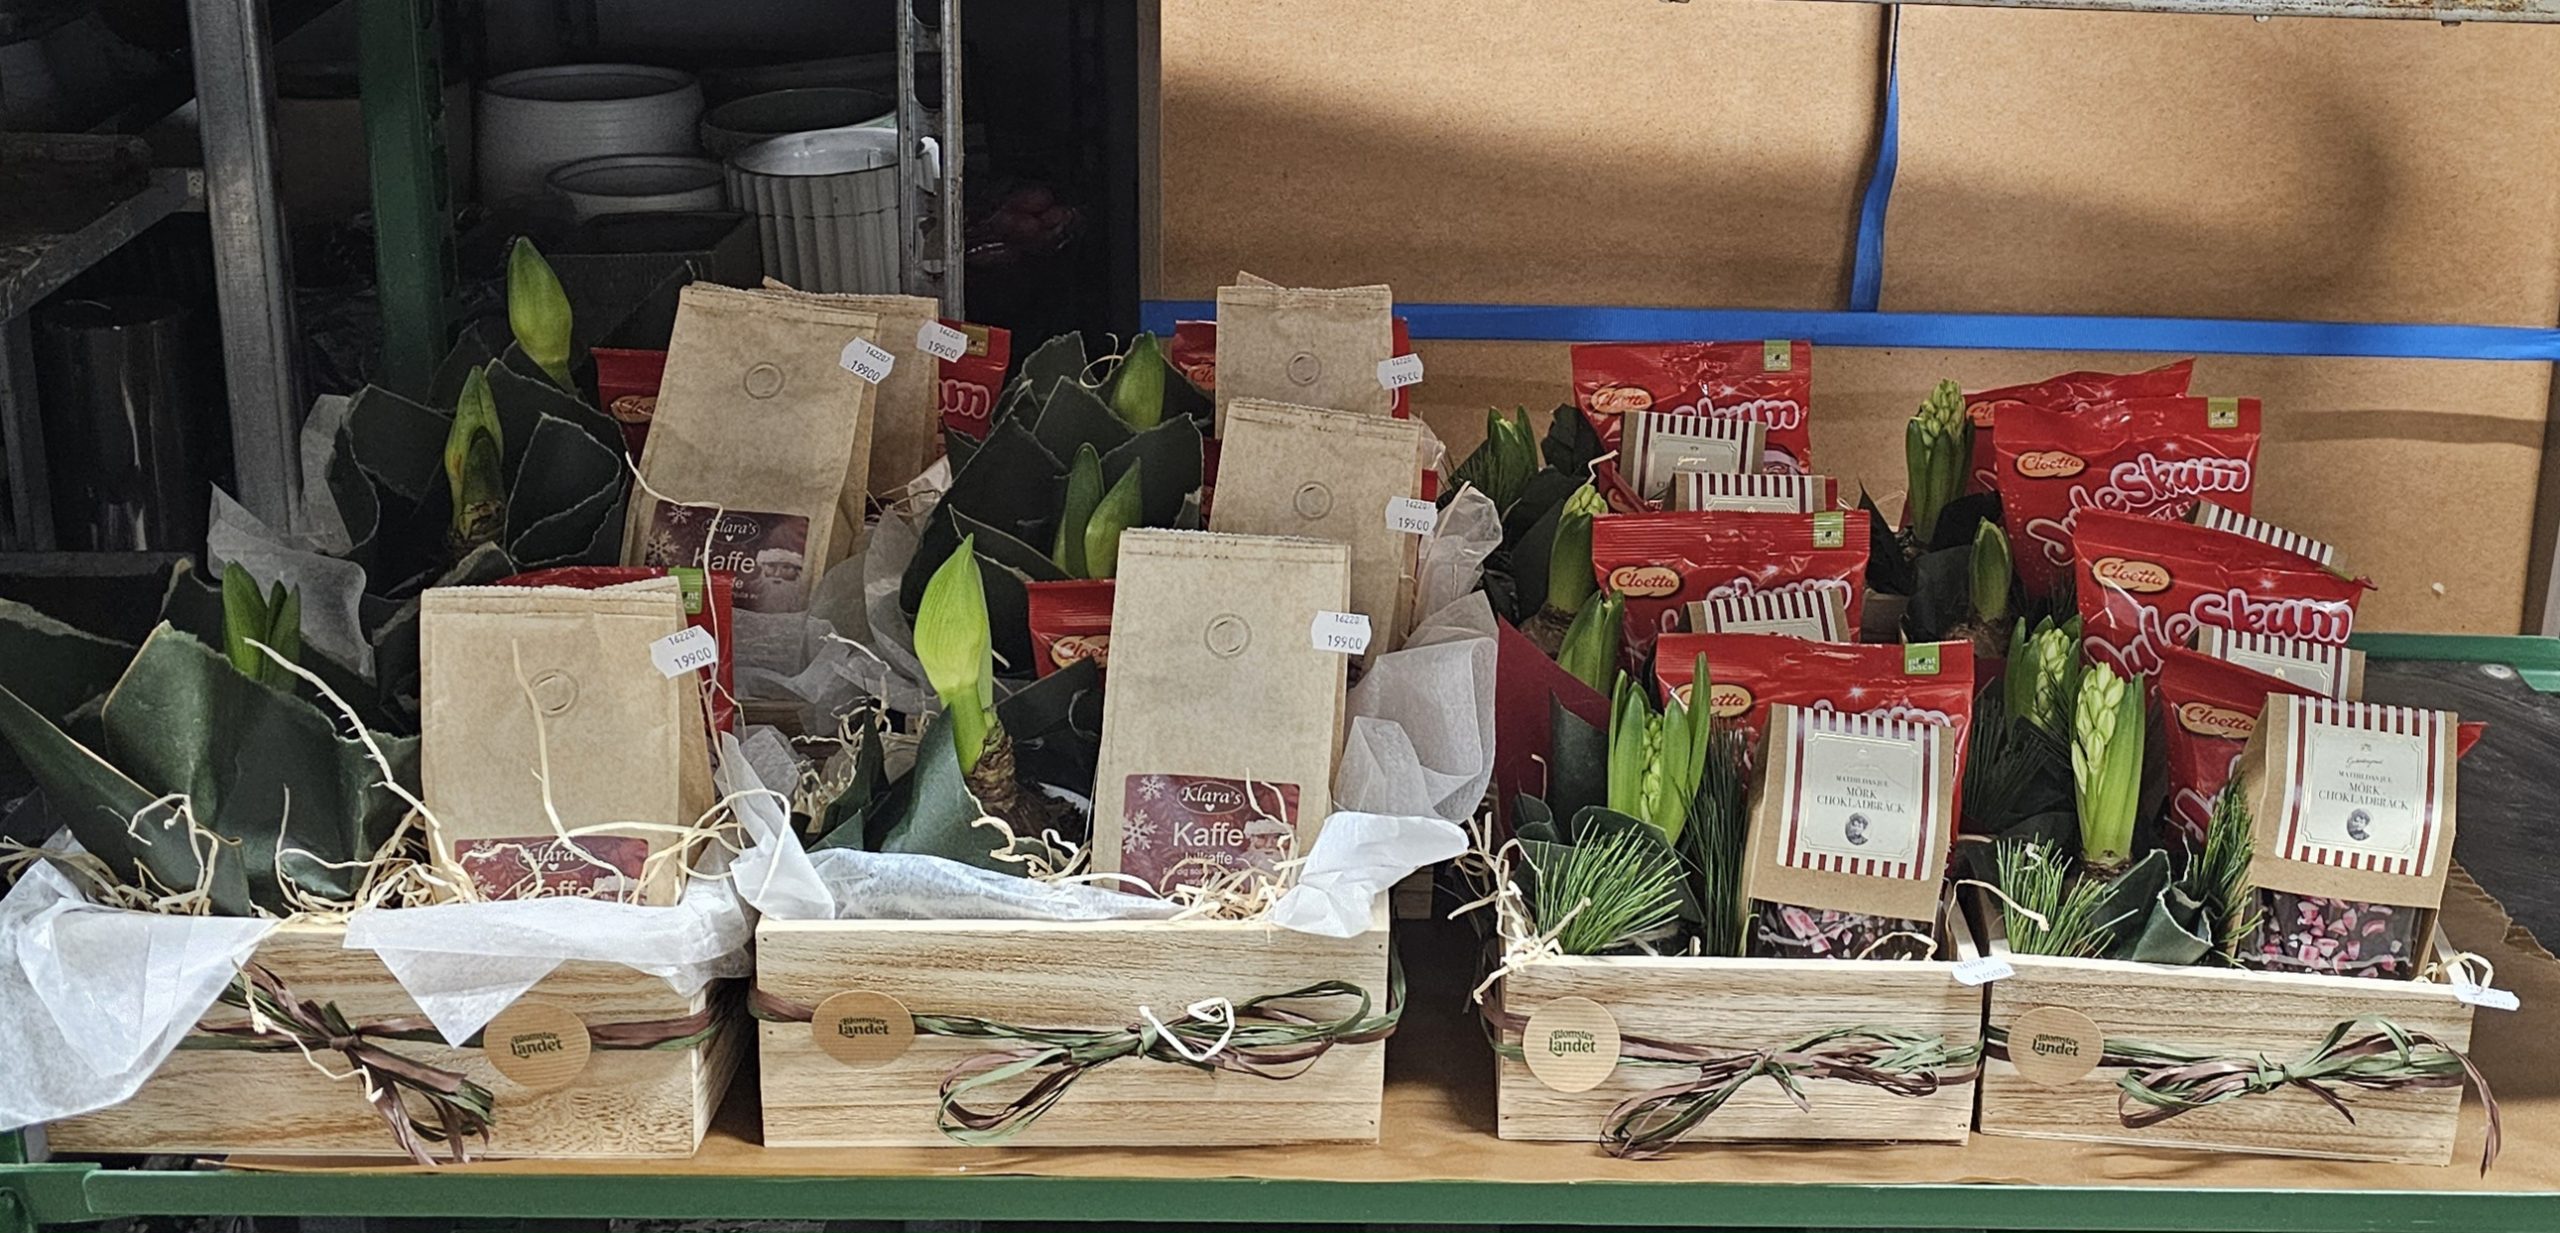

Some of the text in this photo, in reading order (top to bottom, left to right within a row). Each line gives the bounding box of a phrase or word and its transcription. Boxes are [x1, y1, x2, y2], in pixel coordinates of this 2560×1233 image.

[865, 346, 891, 363] 162207
[928, 340, 958, 359] 19900
[851, 360, 881, 381] 19900
[2022, 455, 2081, 471] Cloetta
[1399, 517, 1430, 531] 19900
[692, 547, 756, 574] Kaffe
[1616, 571, 1675, 589] Cloetta
[2099, 561, 2164, 586] Cloetta
[1057, 641, 1110, 660] Cloet
[1328, 635, 1363, 650] 19900
[674, 647, 712, 669] 19900
[1680, 689, 1745, 706] Cetta
[2185, 706, 2254, 732] Cloetta
[1181, 784, 1242, 805] Klara's
[2349, 781, 2381, 796] MÖRK
[1173, 821, 1244, 847] Kaffe
